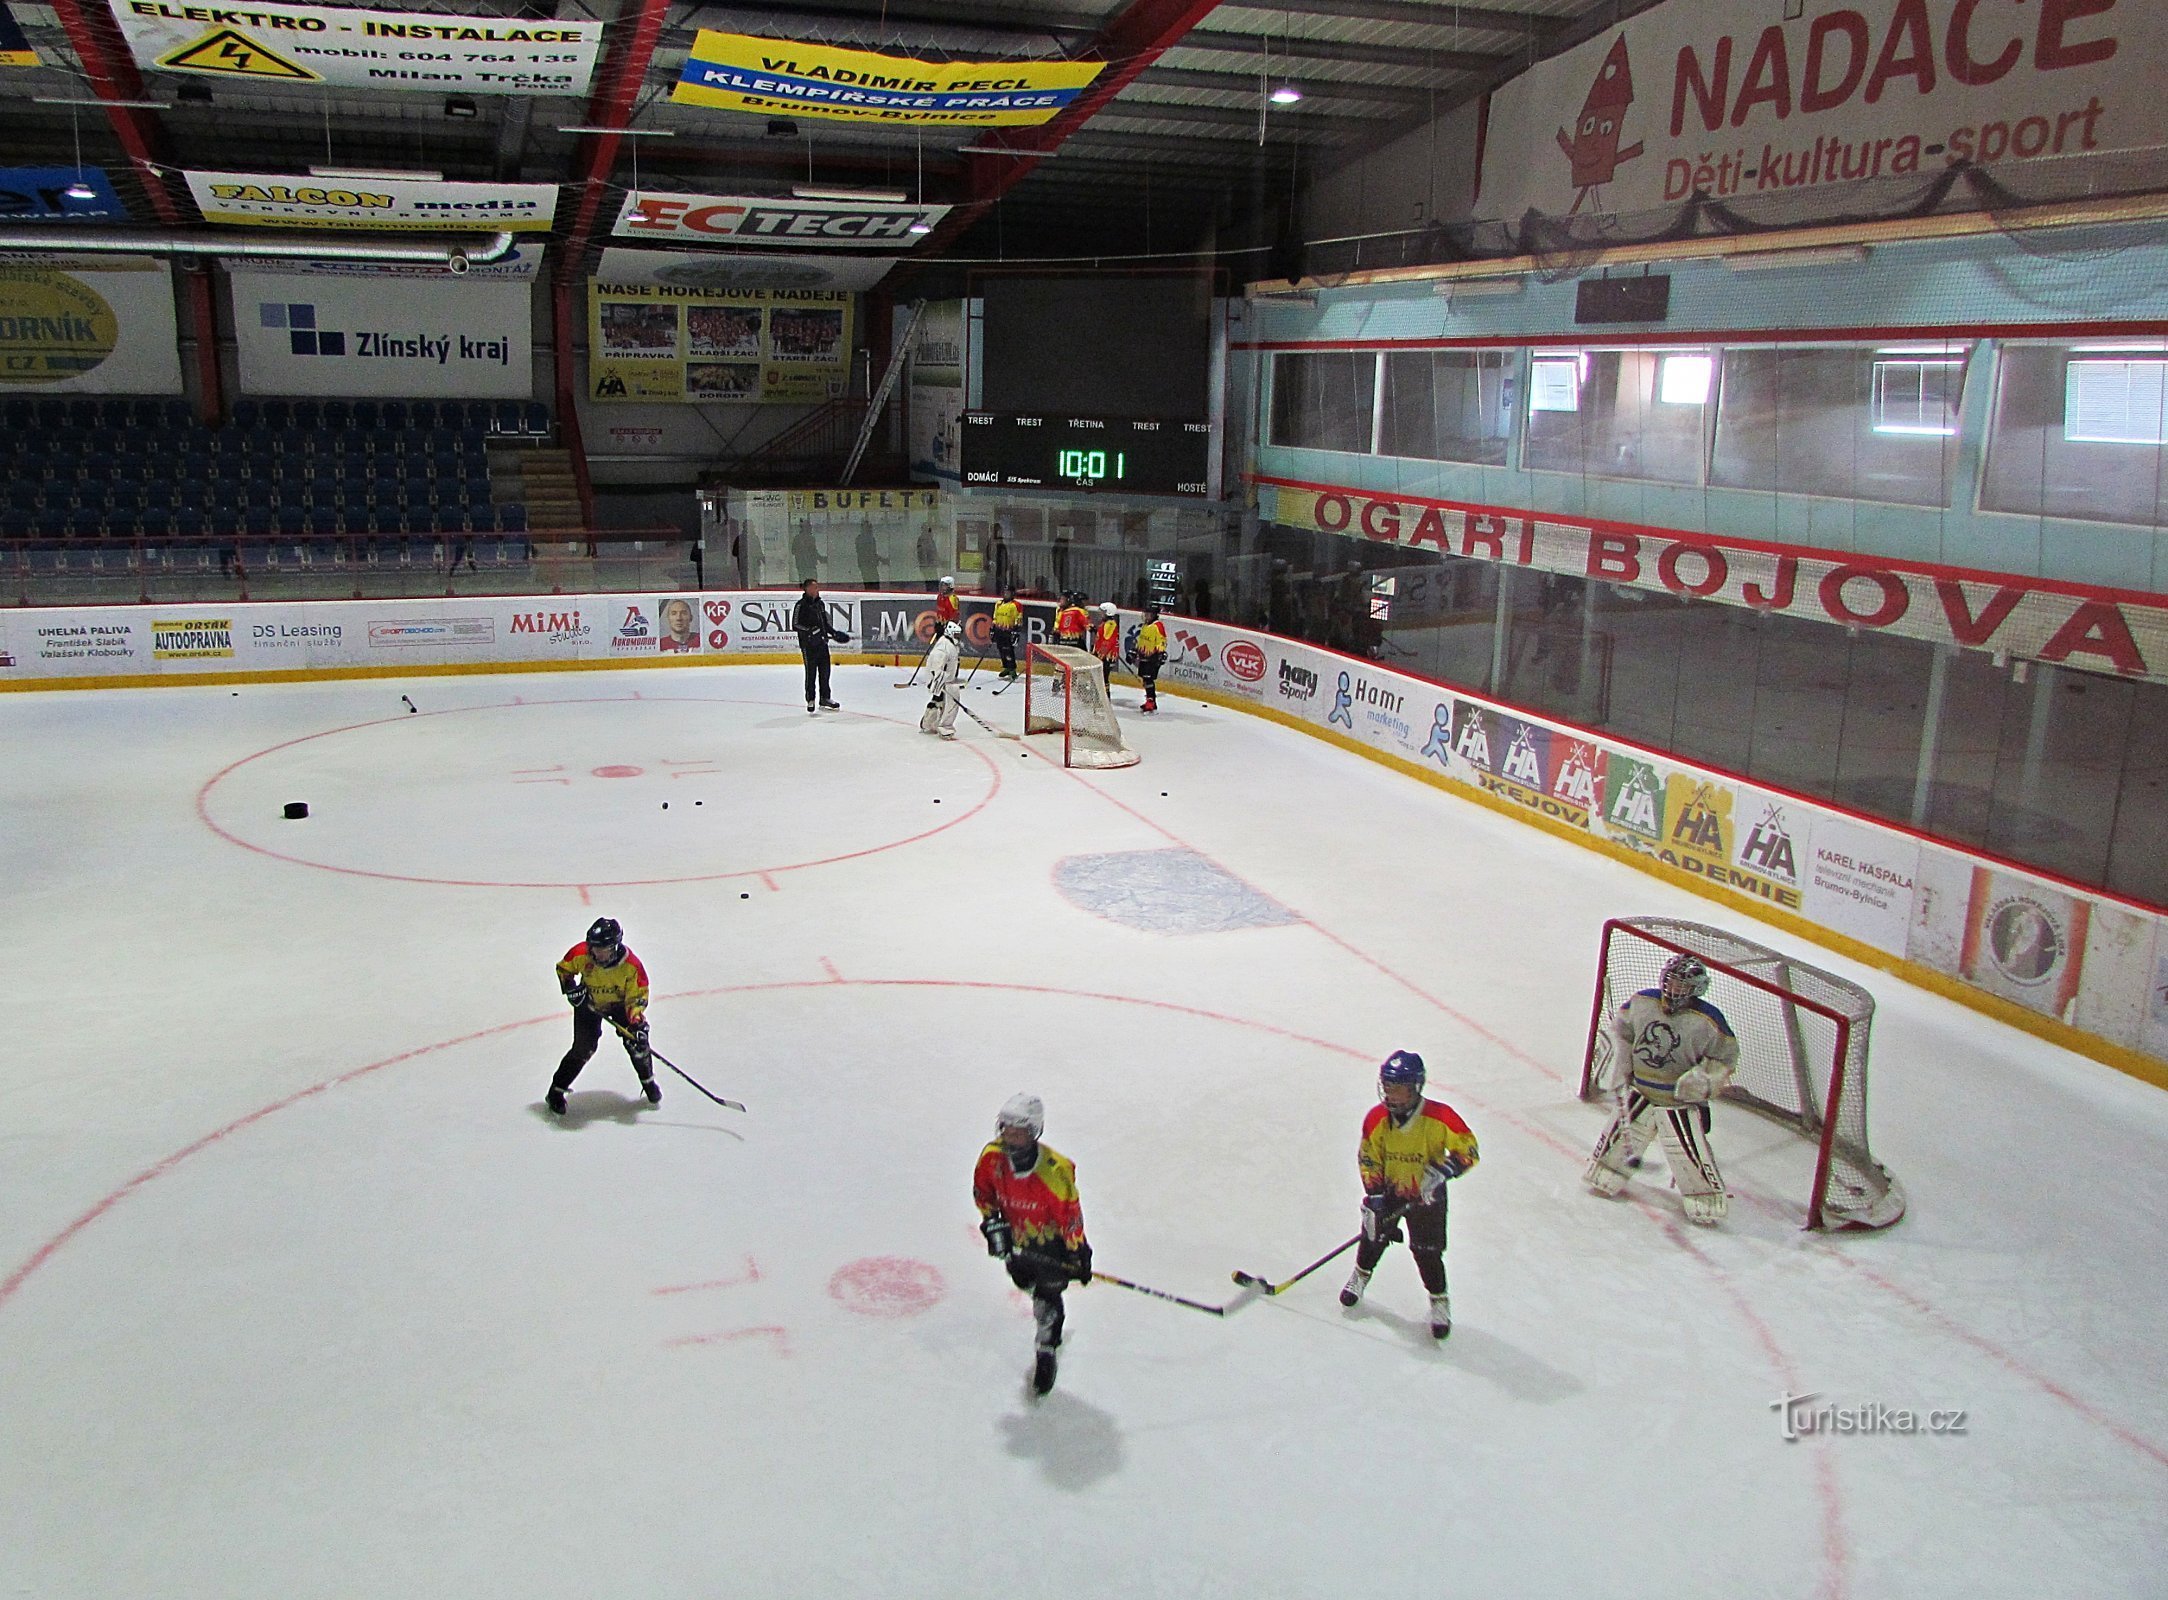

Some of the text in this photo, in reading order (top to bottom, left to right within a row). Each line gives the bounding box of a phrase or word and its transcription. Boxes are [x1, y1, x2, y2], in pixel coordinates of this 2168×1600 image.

[130, 1, 328, 32] ELEKTRO
[365, 21, 583, 43] INSTALACE
[294, 46, 578, 63] mobil: 604 764 135
[369, 69, 573, 84] Milan Trčka
[760, 57, 1033, 92] VLADIMÍR PECL
[1671, 0, 2117, 137] NADACE
[741, 96, 997, 121] Brumov-Bylnice
[210, 184, 537, 211] FALCON media
[355, 333, 509, 365] Zlínský kraj
[968, 416, 1212, 433] TREST TREST TŘETINA TREST TREST
[1058, 450, 1124, 479] 10:01
[967, 471, 999, 484] DOMÁCÍ
[1076, 475, 1094, 487] ČAS
[1177, 481, 1207, 494] HOSTÉ
[813, 491, 915, 509] BUFET
[1314, 492, 1536, 565] OGARI
[705, 604, 729, 617] KR
[740, 602, 855, 633] SALN
[90, 626, 132, 635] PALIVA
[155, 631, 232, 650] AUTOOPRAVNA
[253, 624, 343, 641] DS Leasing
[713, 633, 724, 645] 4
[41, 648, 136, 659] Valašské Klobouky
[46, 639, 93, 648] František
[307, 639, 343, 648] služby
[1231, 656, 1260, 671] VLK
[1279, 680, 1310, 701] Sport
[1355, 678, 1405, 714] Hamr
[1366, 709, 1410, 739] marketing
[1741, 826, 1797, 879] HA
[1816, 848, 1914, 891] KAREL HASPALA
[1813, 875, 1889, 911] Brumov-Bylnice
